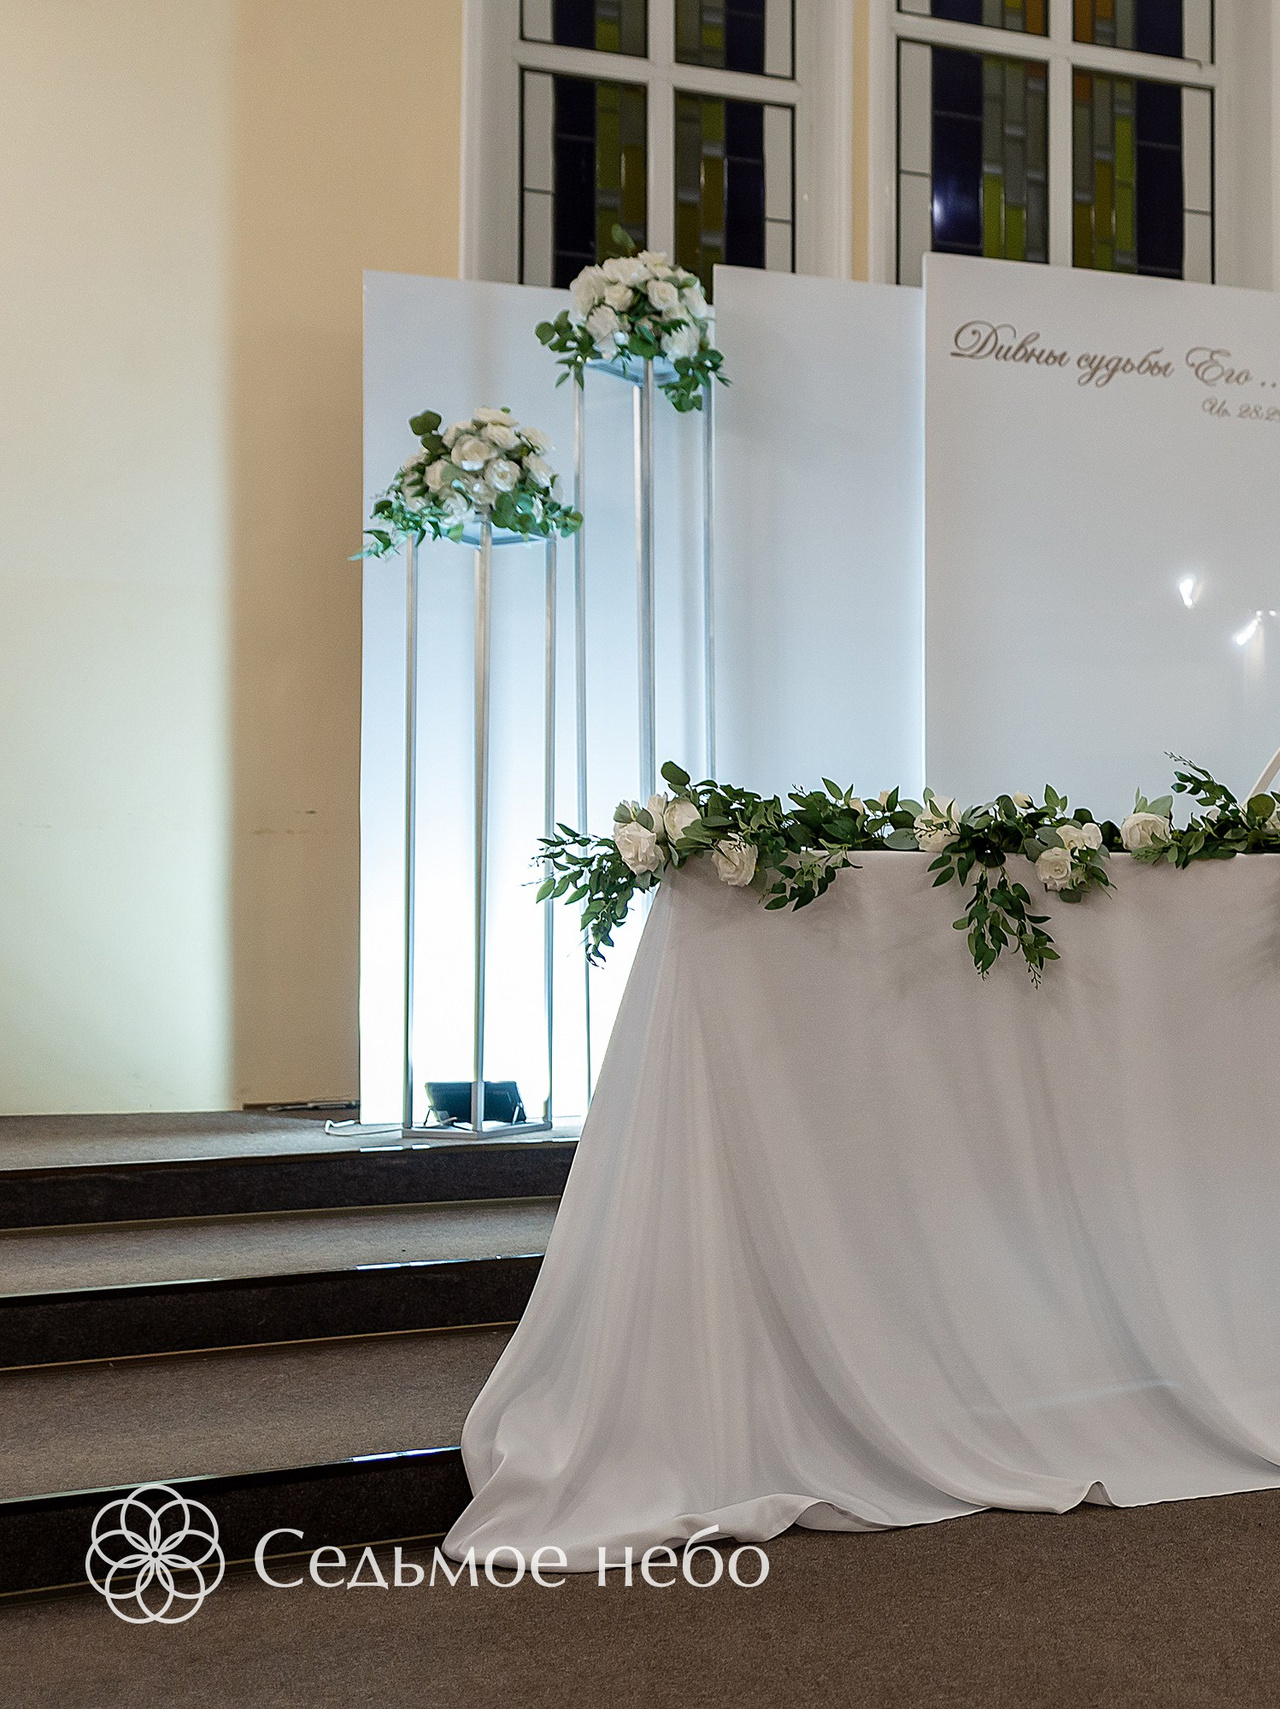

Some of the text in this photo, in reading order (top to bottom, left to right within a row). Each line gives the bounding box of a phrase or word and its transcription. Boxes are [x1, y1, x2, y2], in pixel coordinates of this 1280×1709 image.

[950, 319, 1071, 367] Дивны
[1076, 347, 1175, 388] судьбы
[1185, 346, 1252, 387] Его
